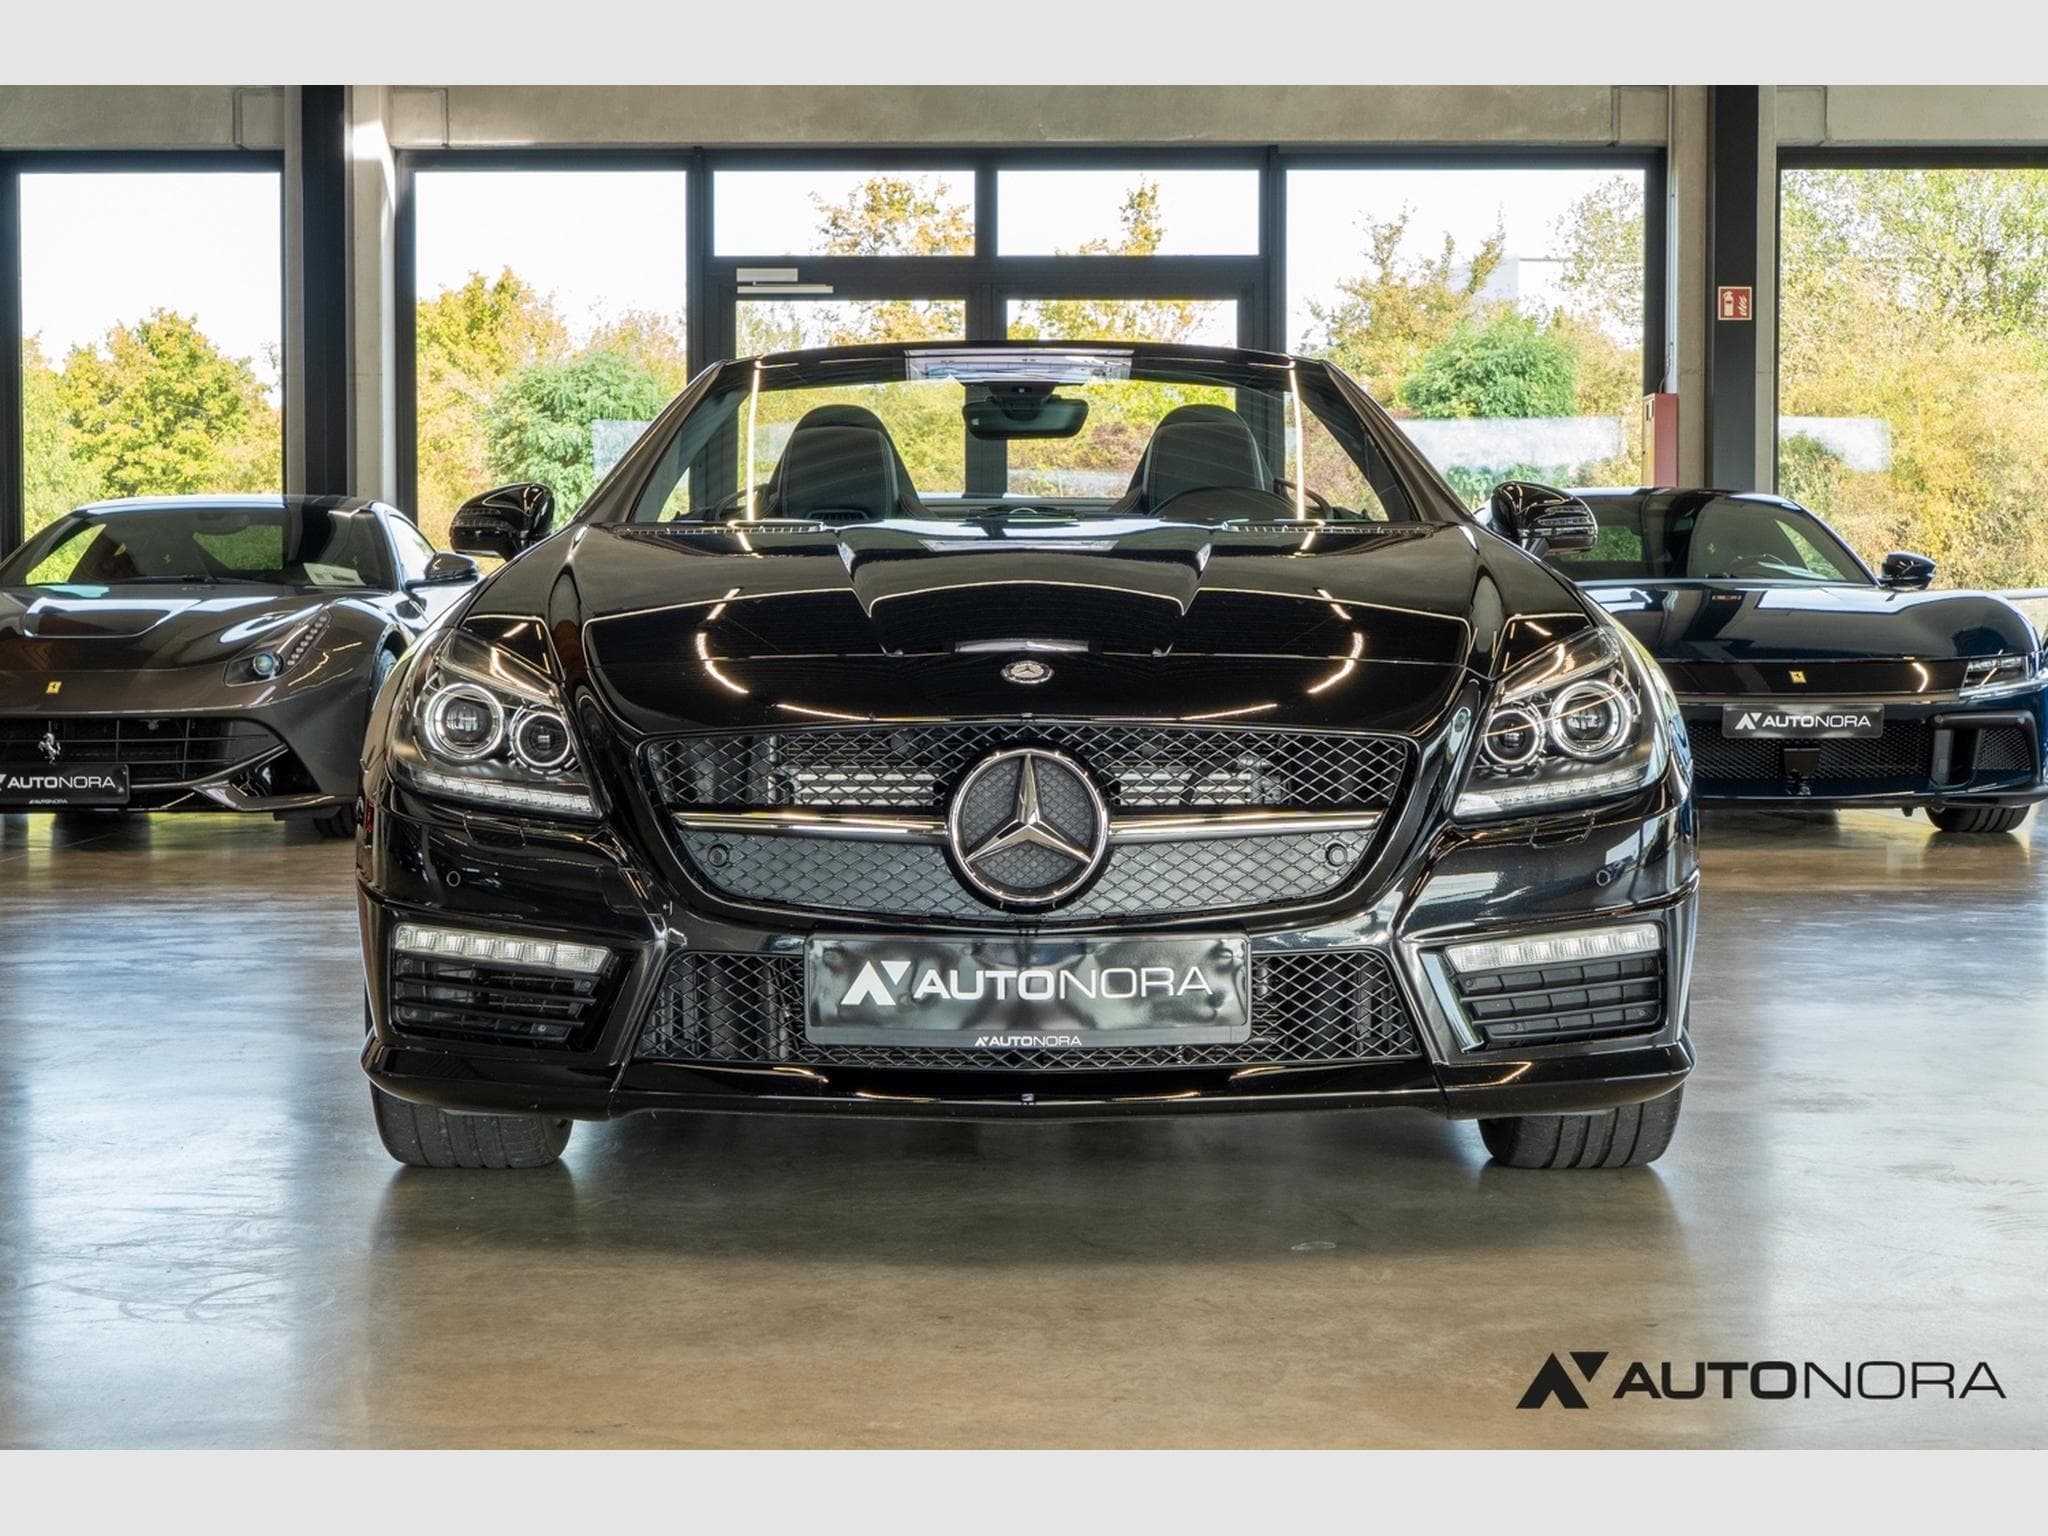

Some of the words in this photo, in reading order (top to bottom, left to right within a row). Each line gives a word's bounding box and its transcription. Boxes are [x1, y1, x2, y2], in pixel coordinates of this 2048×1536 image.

[1762, 714, 1871, 728] AUTONORA
[7, 775, 116, 789] AUTONORA
[913, 966, 1213, 1000] AUTONORA
[988, 1035, 1083, 1047] AUTONORA
